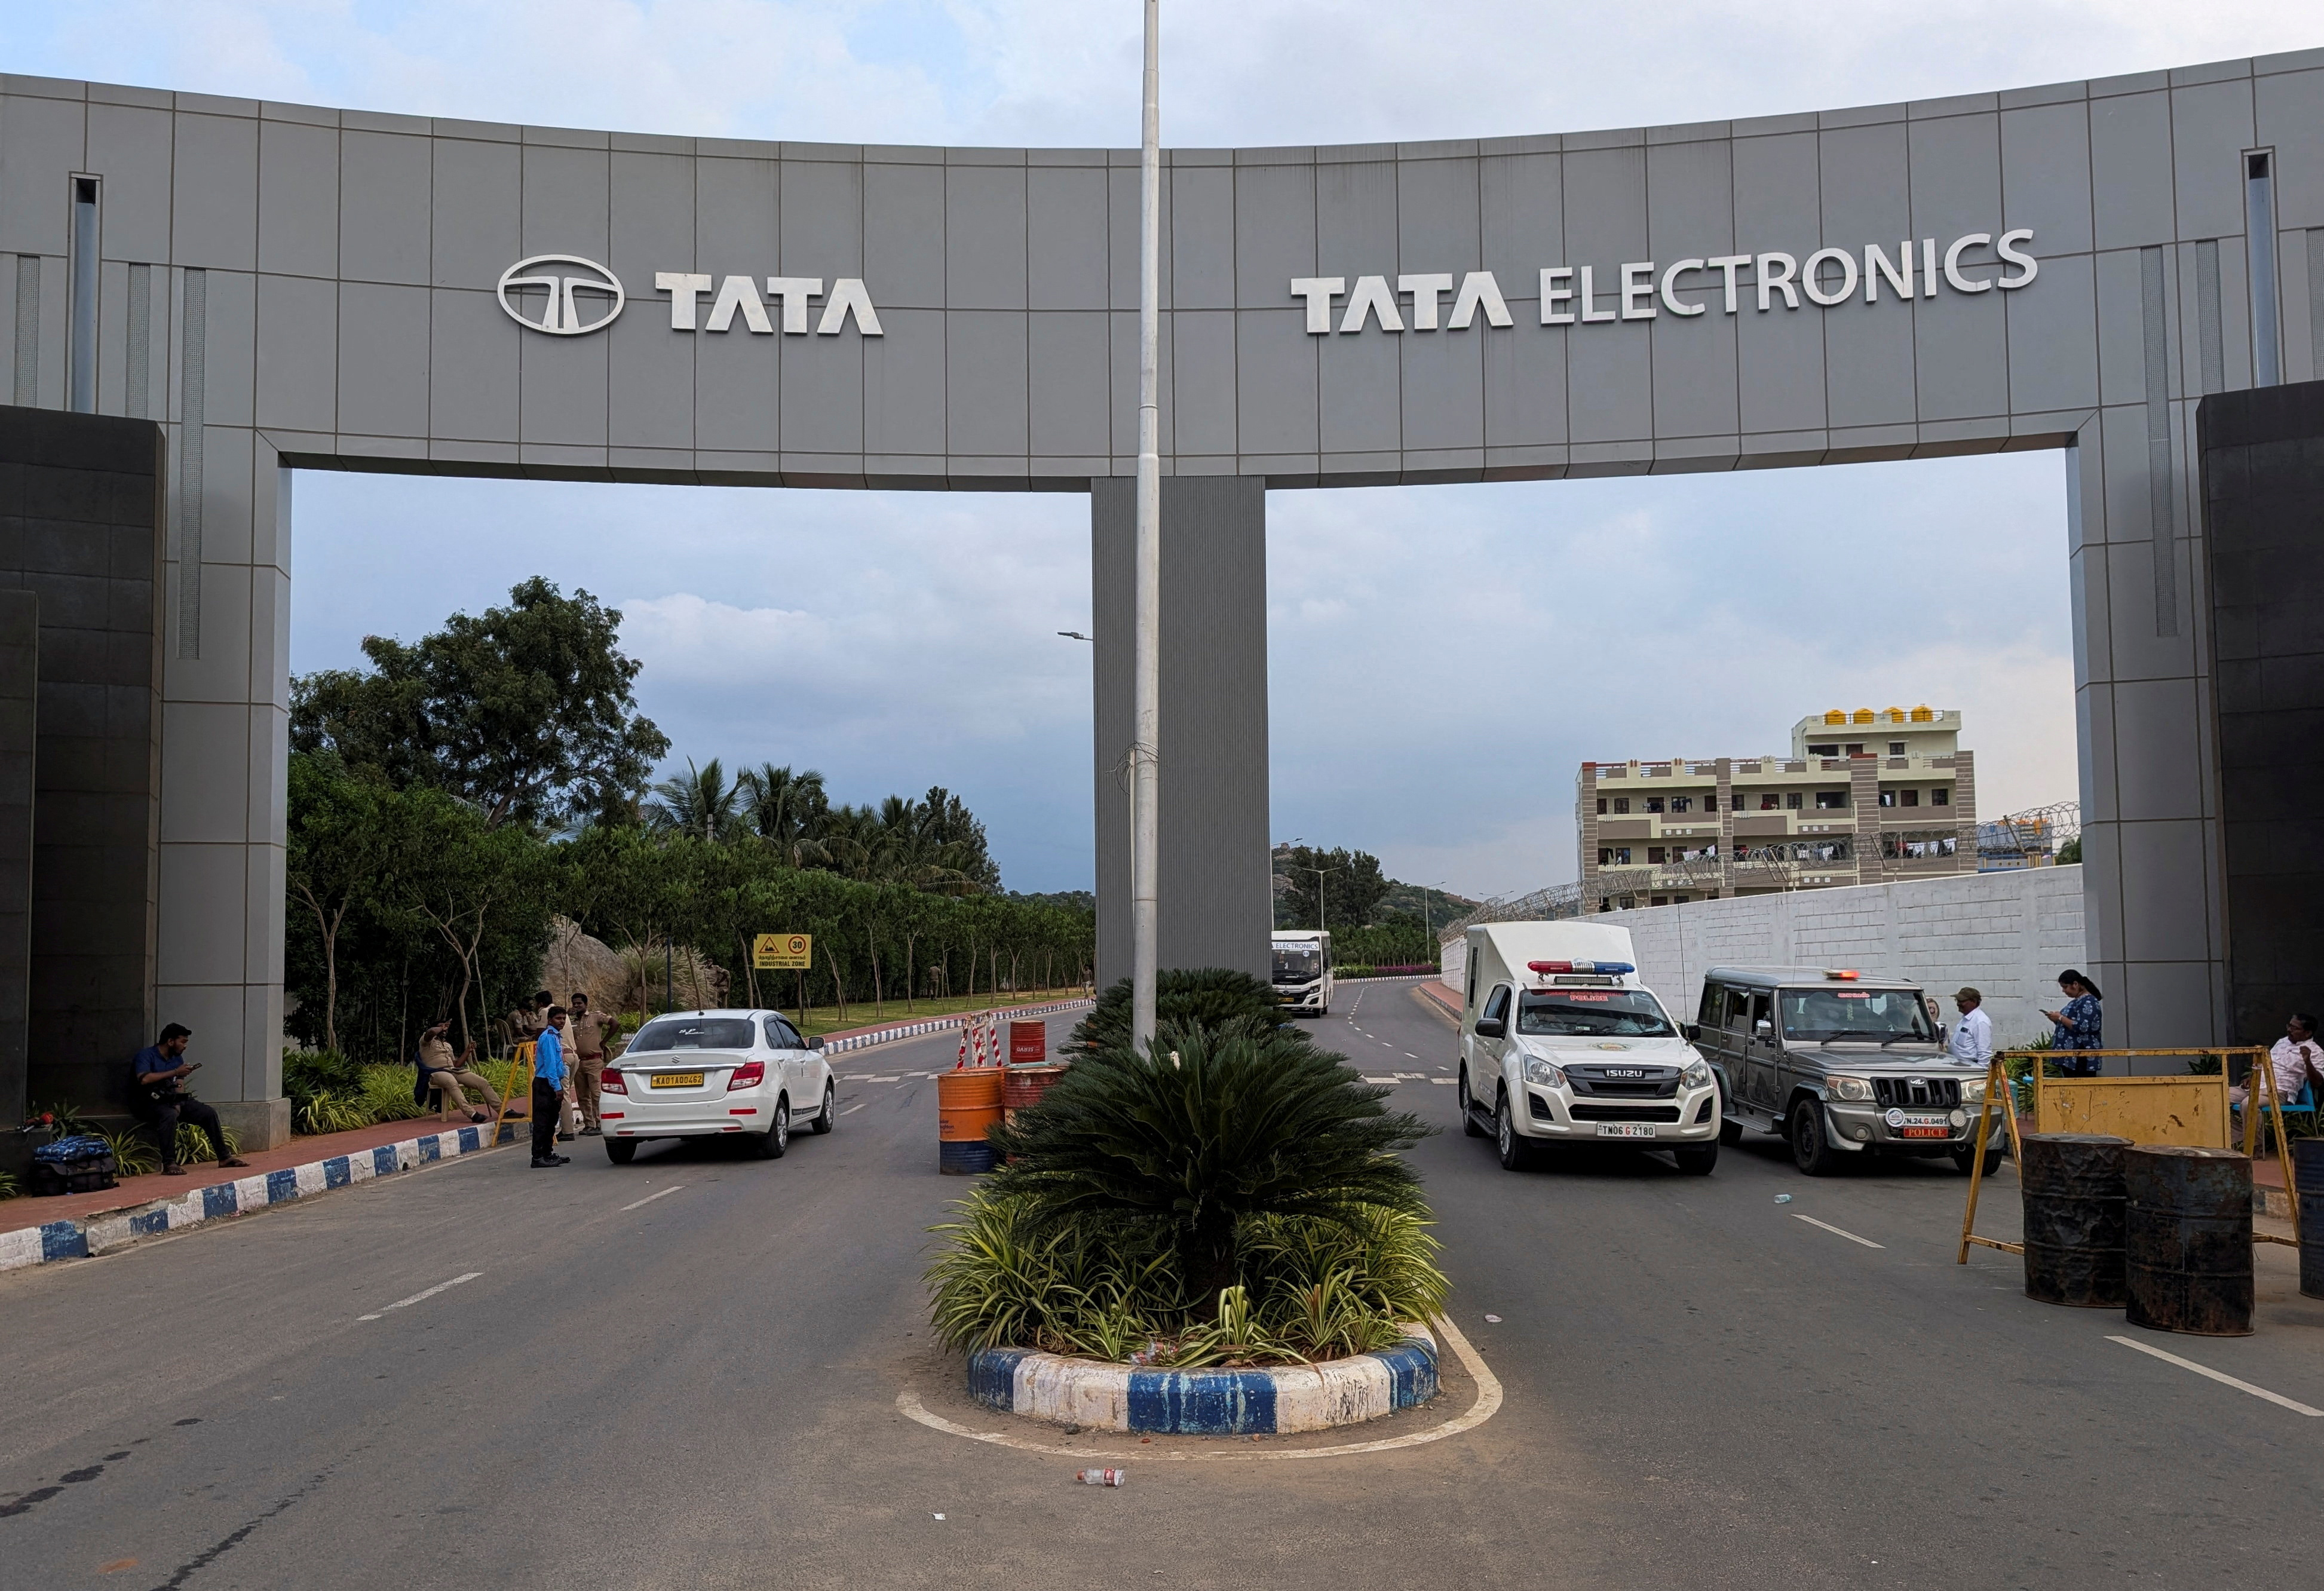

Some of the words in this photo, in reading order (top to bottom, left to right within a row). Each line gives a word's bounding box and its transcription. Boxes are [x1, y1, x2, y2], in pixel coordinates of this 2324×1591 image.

[655, 272, 884, 335] TATA
[1291, 270, 1514, 333] TATA
[1539, 229, 2039, 325] ELECTRONICS
[1602, 1126, 1623, 1135] TN06
[1626, 1126, 1630, 1135] G
[1633, 1126, 1654, 1135] 2180
